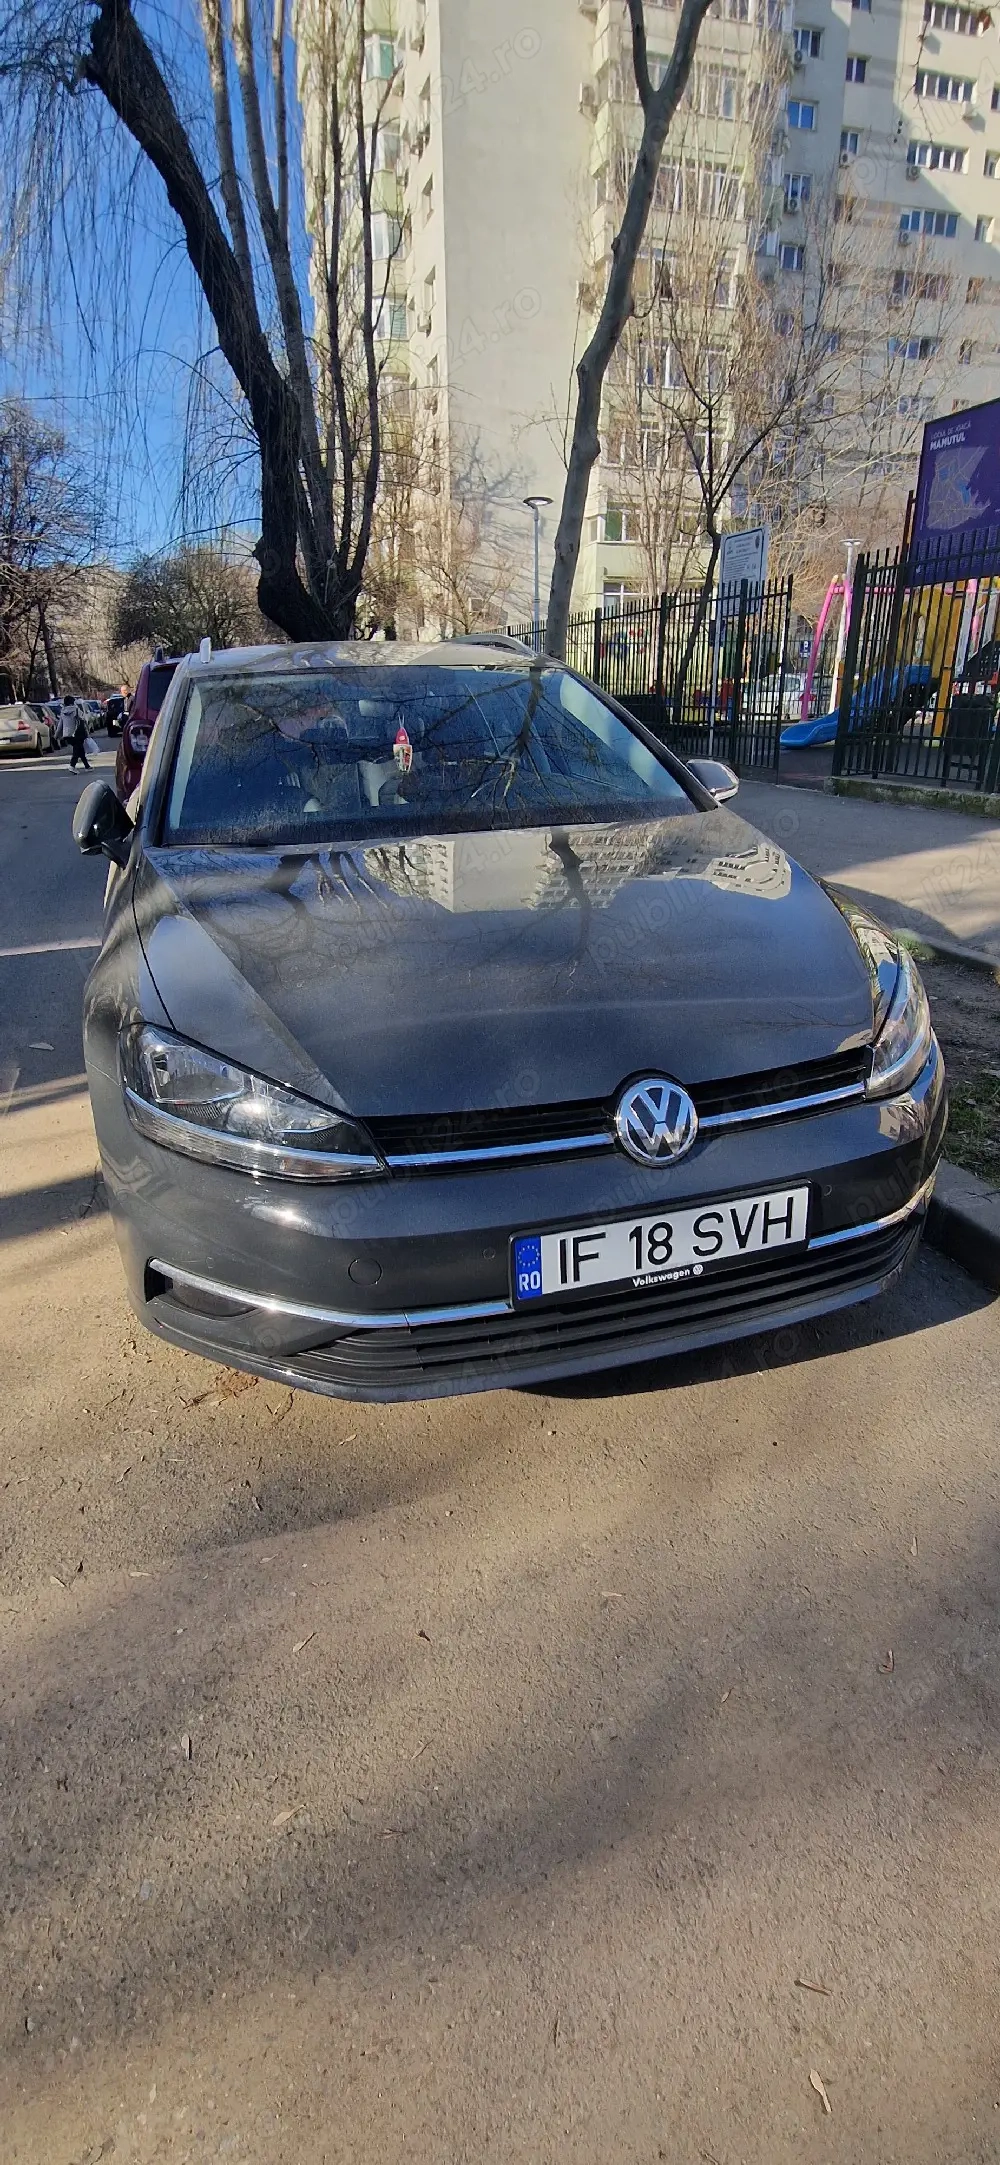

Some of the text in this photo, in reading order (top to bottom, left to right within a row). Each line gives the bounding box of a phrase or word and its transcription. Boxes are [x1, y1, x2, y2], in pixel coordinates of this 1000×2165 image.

[929, 431, 966, 451] MAMUTUL
[558, 1196, 795, 1285] IF 18 SVH
[519, 1270, 541, 1292] RO
[632, 1268, 690, 1288] Volkswagen
